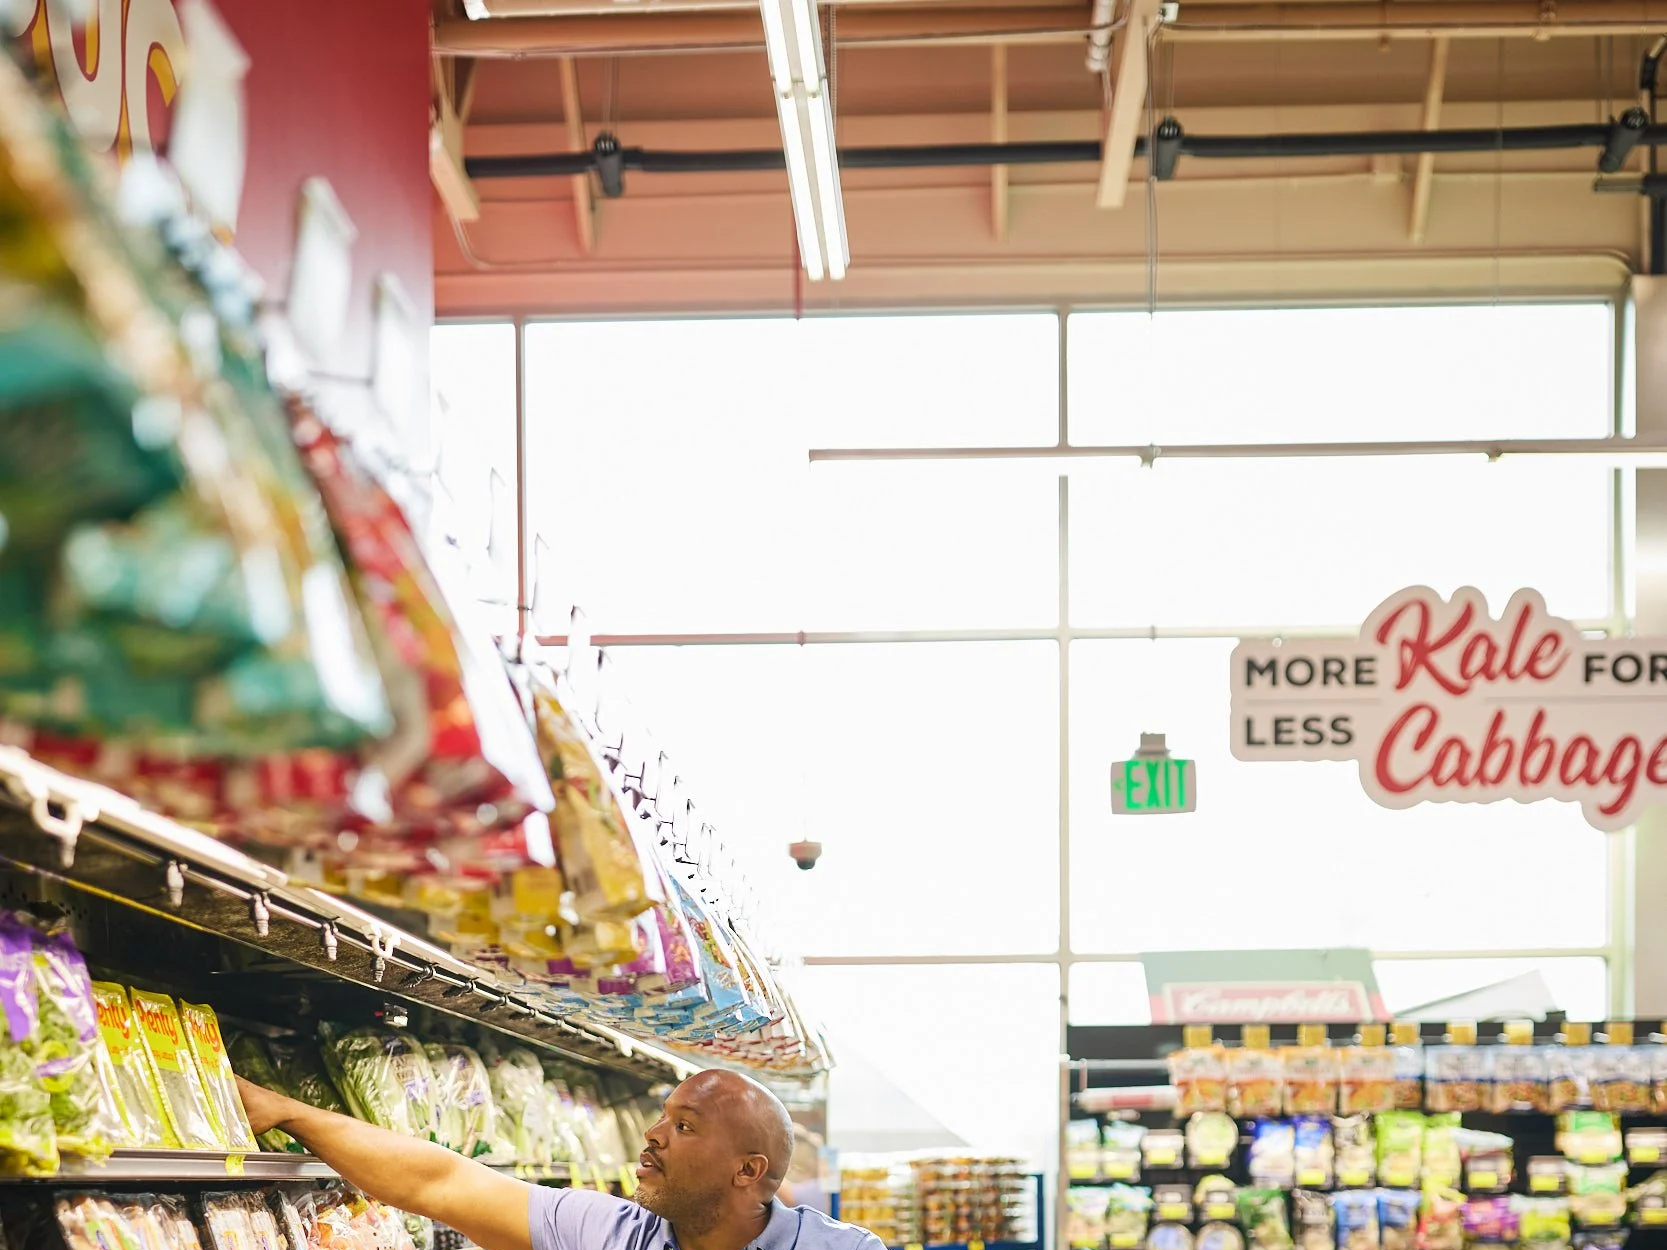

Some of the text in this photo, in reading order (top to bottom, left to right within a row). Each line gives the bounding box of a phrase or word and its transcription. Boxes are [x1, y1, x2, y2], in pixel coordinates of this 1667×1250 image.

[1245, 599, 1667, 695] MORE Kale FOR
[1123, 758, 1189, 810] EXIT
[1245, 703, 1667, 816] LESS Cabbage
